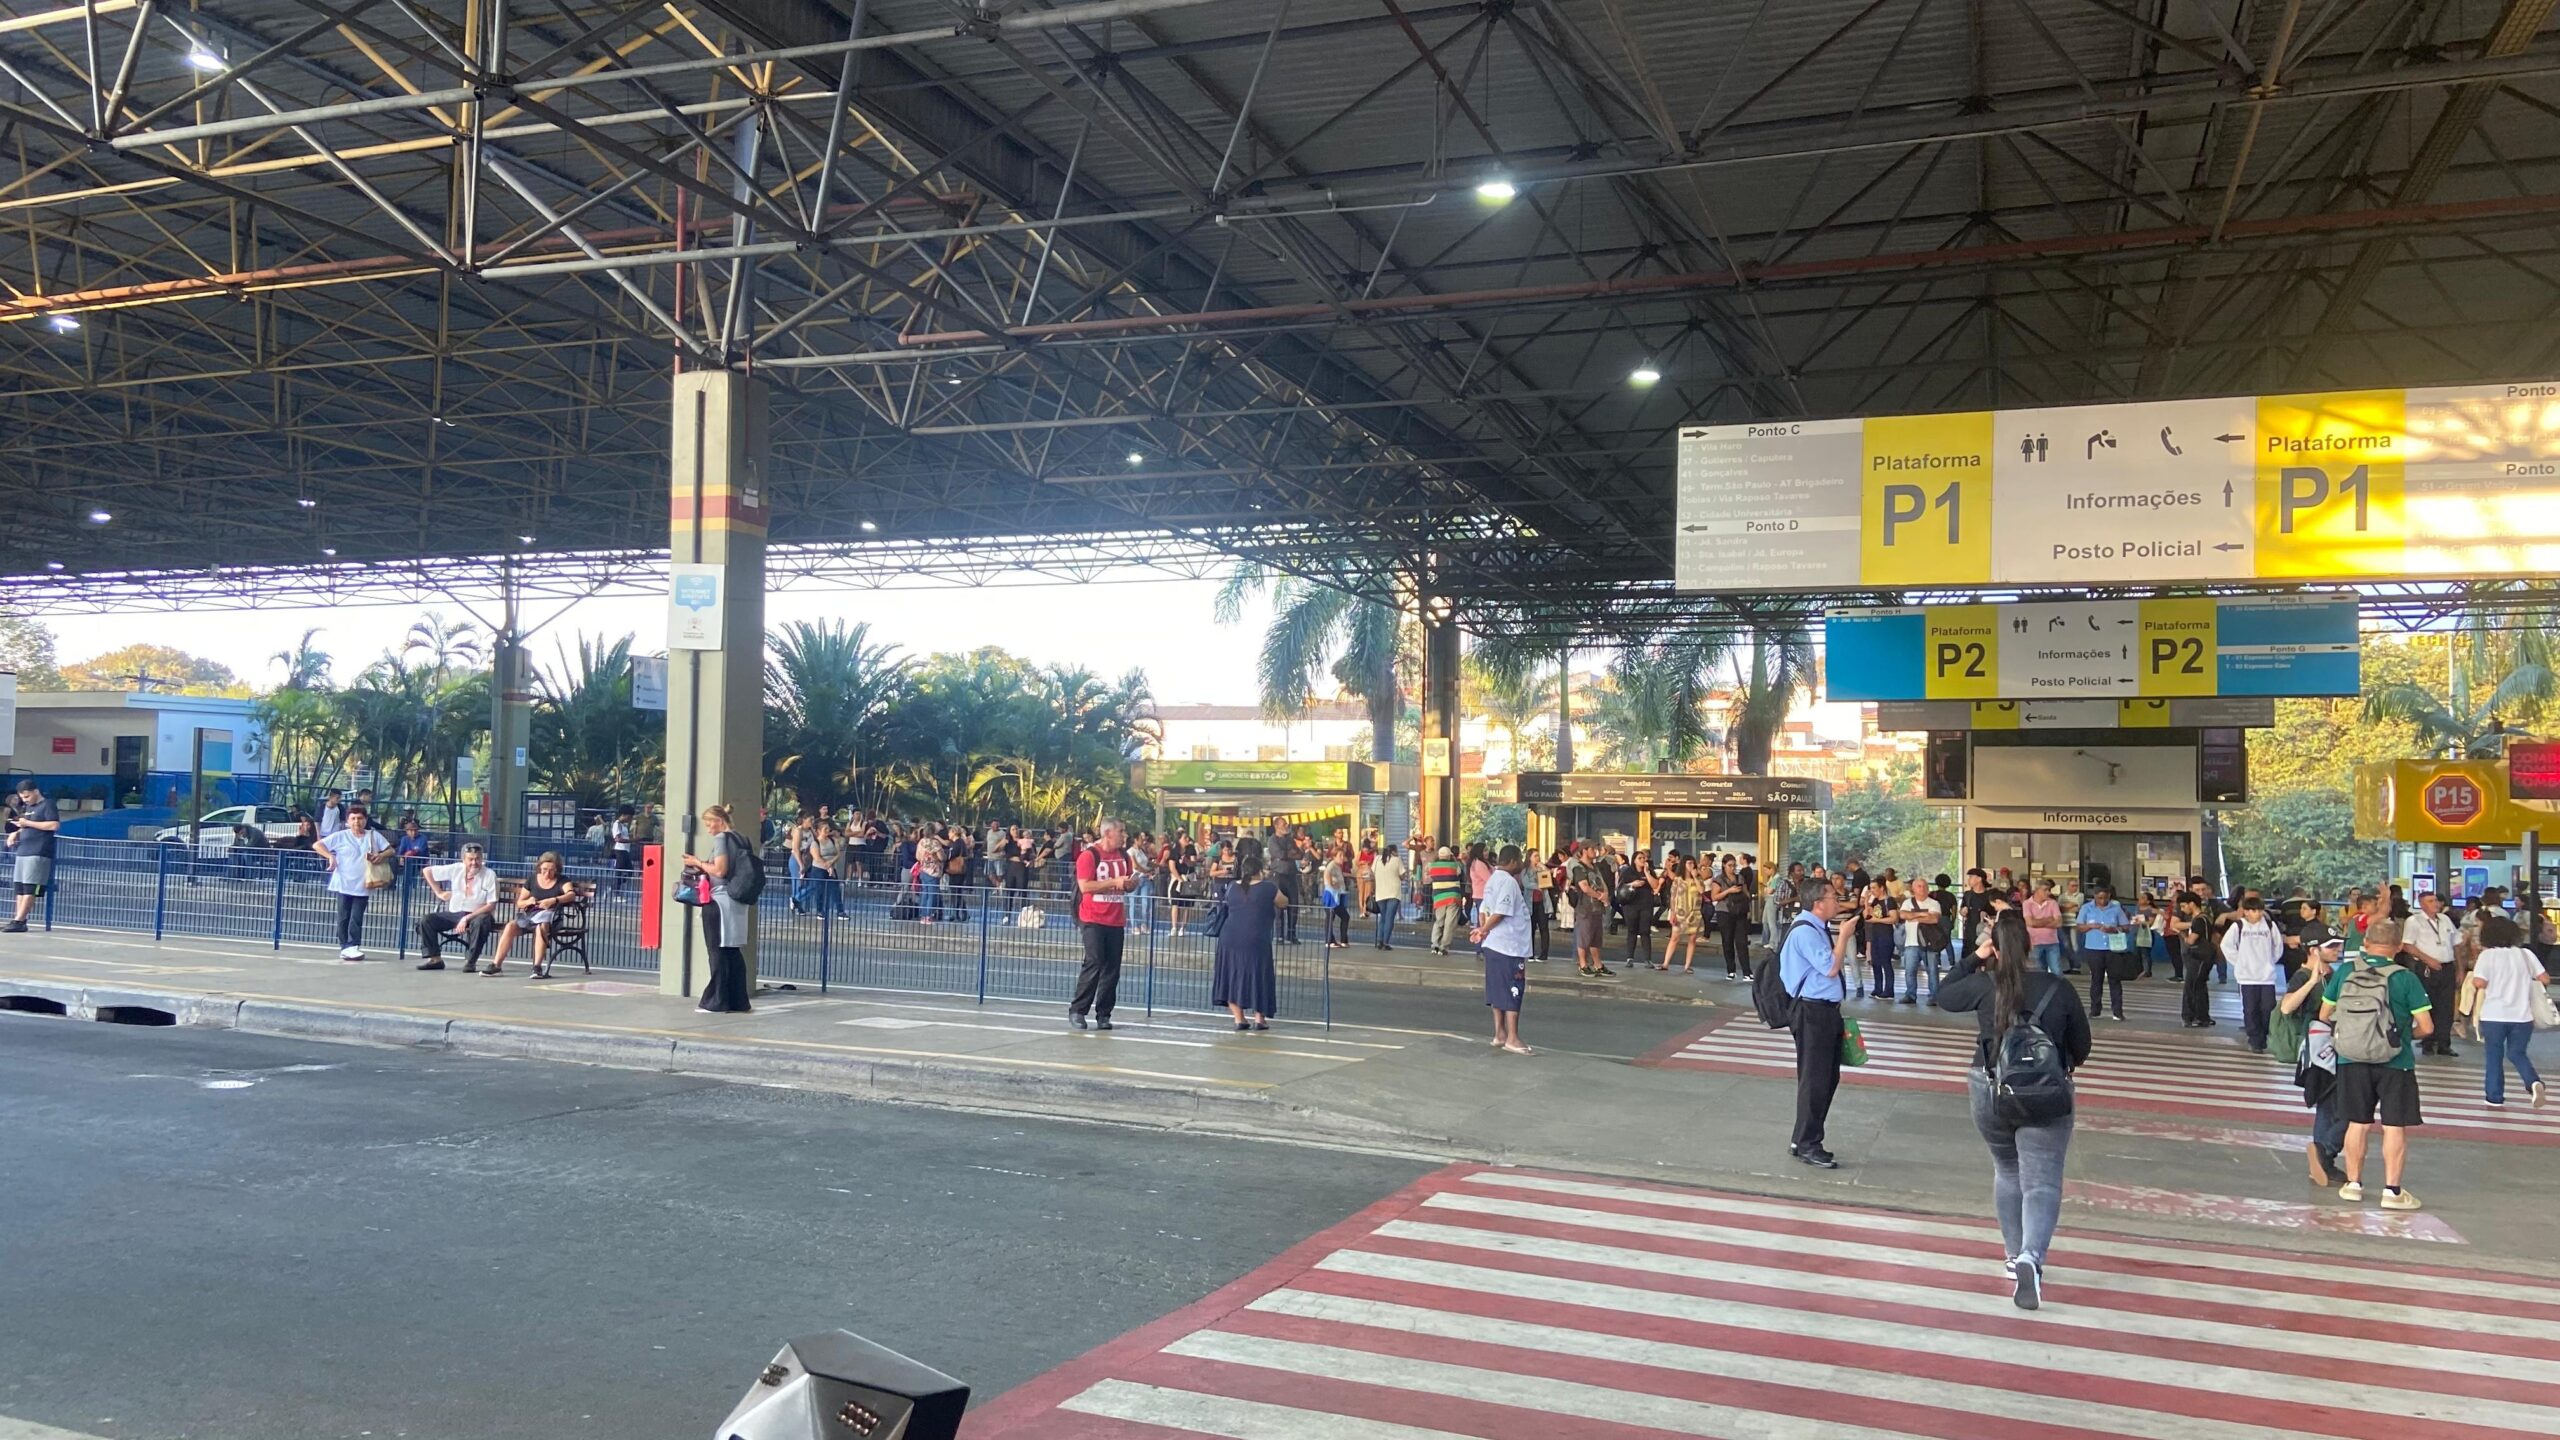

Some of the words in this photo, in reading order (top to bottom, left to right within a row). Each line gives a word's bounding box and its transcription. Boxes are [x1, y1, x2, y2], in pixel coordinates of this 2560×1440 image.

[2507, 386, 2557, 397] Ponto
[1748, 426, 1787, 437] Ponto
[1790, 424, 1801, 435] C
[2267, 433, 2391, 453] Plataforma
[1872, 452, 1981, 472] Plataforma
[2506, 463, 2556, 476] Ponto
[1795, 477, 1844, 488] Brigadeiro
[1735, 492, 1770, 503] Raposo
[2066, 489, 2202, 512] Informações
[2279, 464, 2369, 534] P1
[1883, 480, 1960, 547] P1
[1746, 521, 1785, 532] Ponto
[1789, 519, 1799, 531] D
[1769, 548, 1804, 558] Europa
[2052, 543, 2114, 560] Posto
[2121, 540, 2202, 558] Policial
[1931, 626, 1992, 637] Plataforma
[2144, 620, 2210, 631] Plataforma
[2038, 648, 2111, 661] Informações
[2270, 645, 2297, 653] Ponto
[1937, 642, 1986, 678] P2
[2151, 637, 2204, 675] P2
[2031, 677, 2065, 687] Posto
[2068, 676, 2112, 687] Policial
[1250, 770, 1288, 780] ESTAÇÃO
[1619, 779, 1651, 787] Cometa
[1699, 780, 1733, 788] Cometa
[1524, 790, 1539, 798] SÃO
[1767, 792, 1788, 802] SÃO
[2434, 786, 2473, 805] P15
[2043, 812, 2128, 826] Informações
